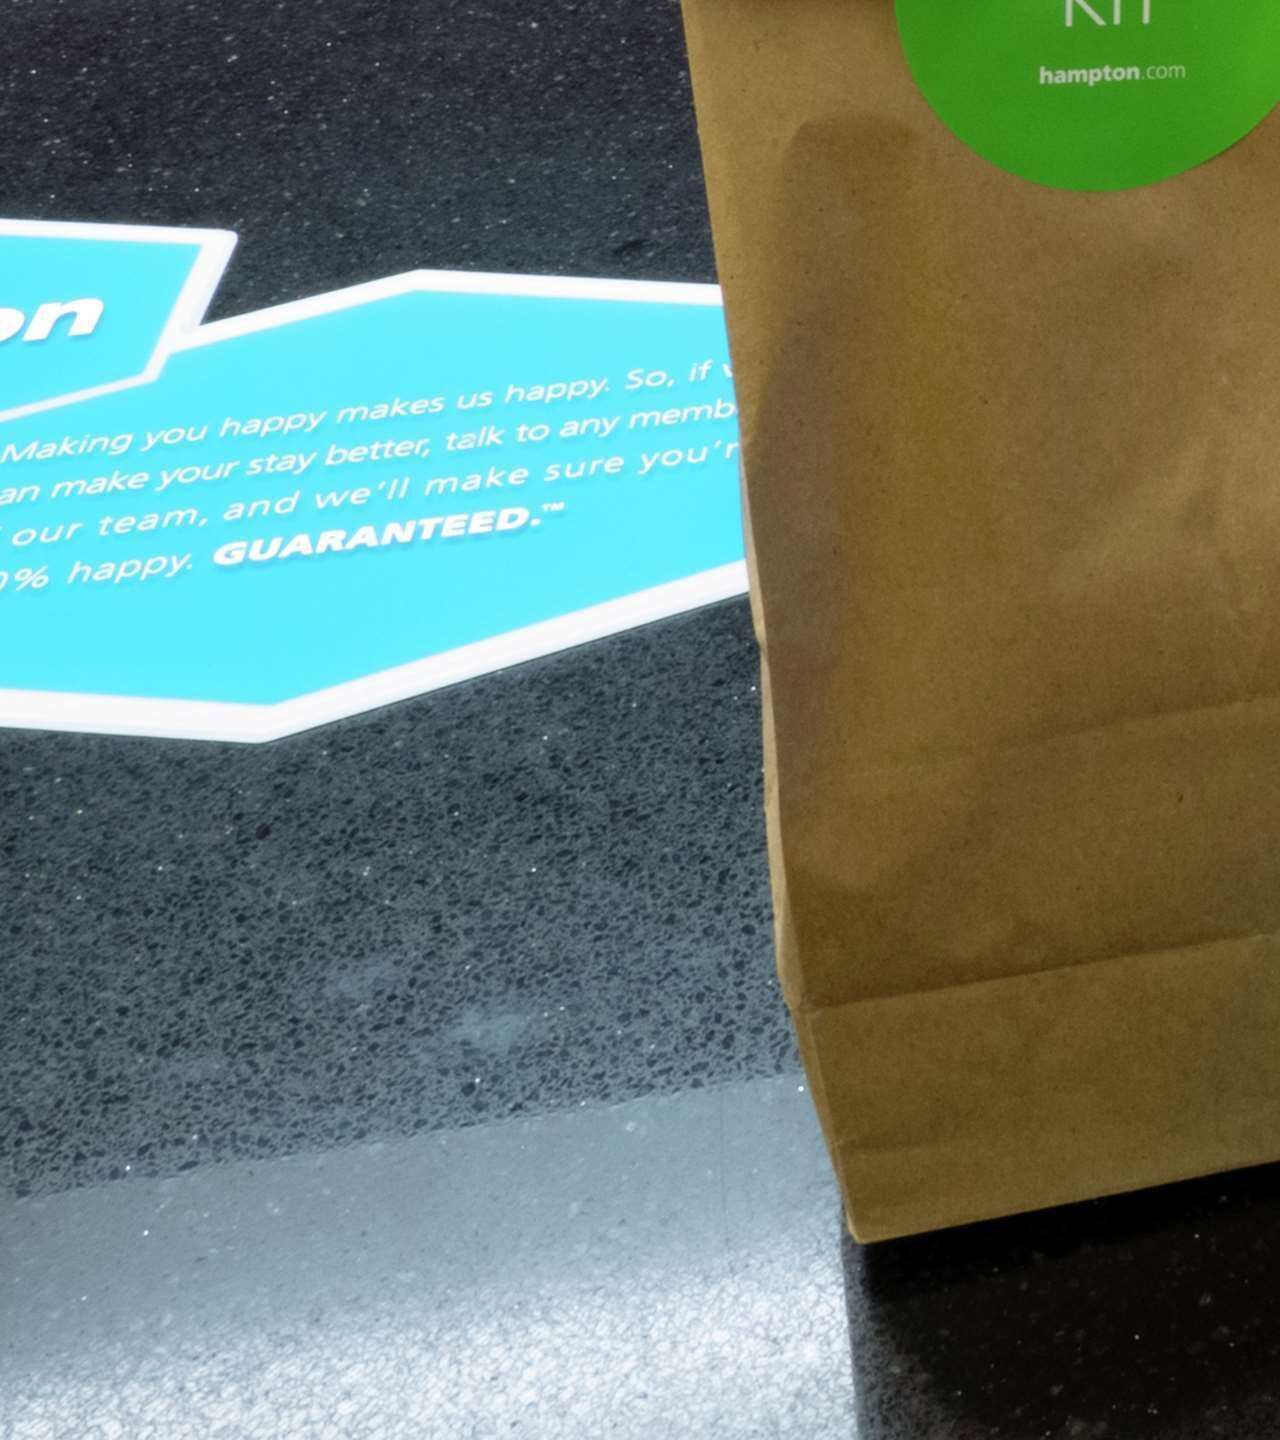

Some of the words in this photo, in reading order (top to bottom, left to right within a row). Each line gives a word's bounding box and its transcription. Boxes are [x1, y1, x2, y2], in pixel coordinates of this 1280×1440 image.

[1039, 62, 1186, 86] hampton.com
[0, 433, 133, 465] Making
[141, 425, 208, 451] you
[219, 407, 326, 439] happy
[336, 394, 445, 424] makes
[456, 389, 494, 409] us
[504, 375, 611, 409] happy.
[625, 367, 675, 390] So,
[689, 359, 714, 381] if
[50, 470, 149, 500] make
[157, 459, 240, 492] your
[246, 449, 314, 479] stay
[326, 432, 431, 467] better,
[446, 424, 504, 447] talk
[519, 419, 551, 443] to
[558, 412, 620, 443] any
[12, 520, 84, 547] our
[98, 506, 208, 537] team,
[222, 492, 301, 521] and
[314, 475, 410, 510] we'll
[424, 468, 530, 497] make
[543, 453, 625, 482] sure
[67, 552, 193, 585] happy.
